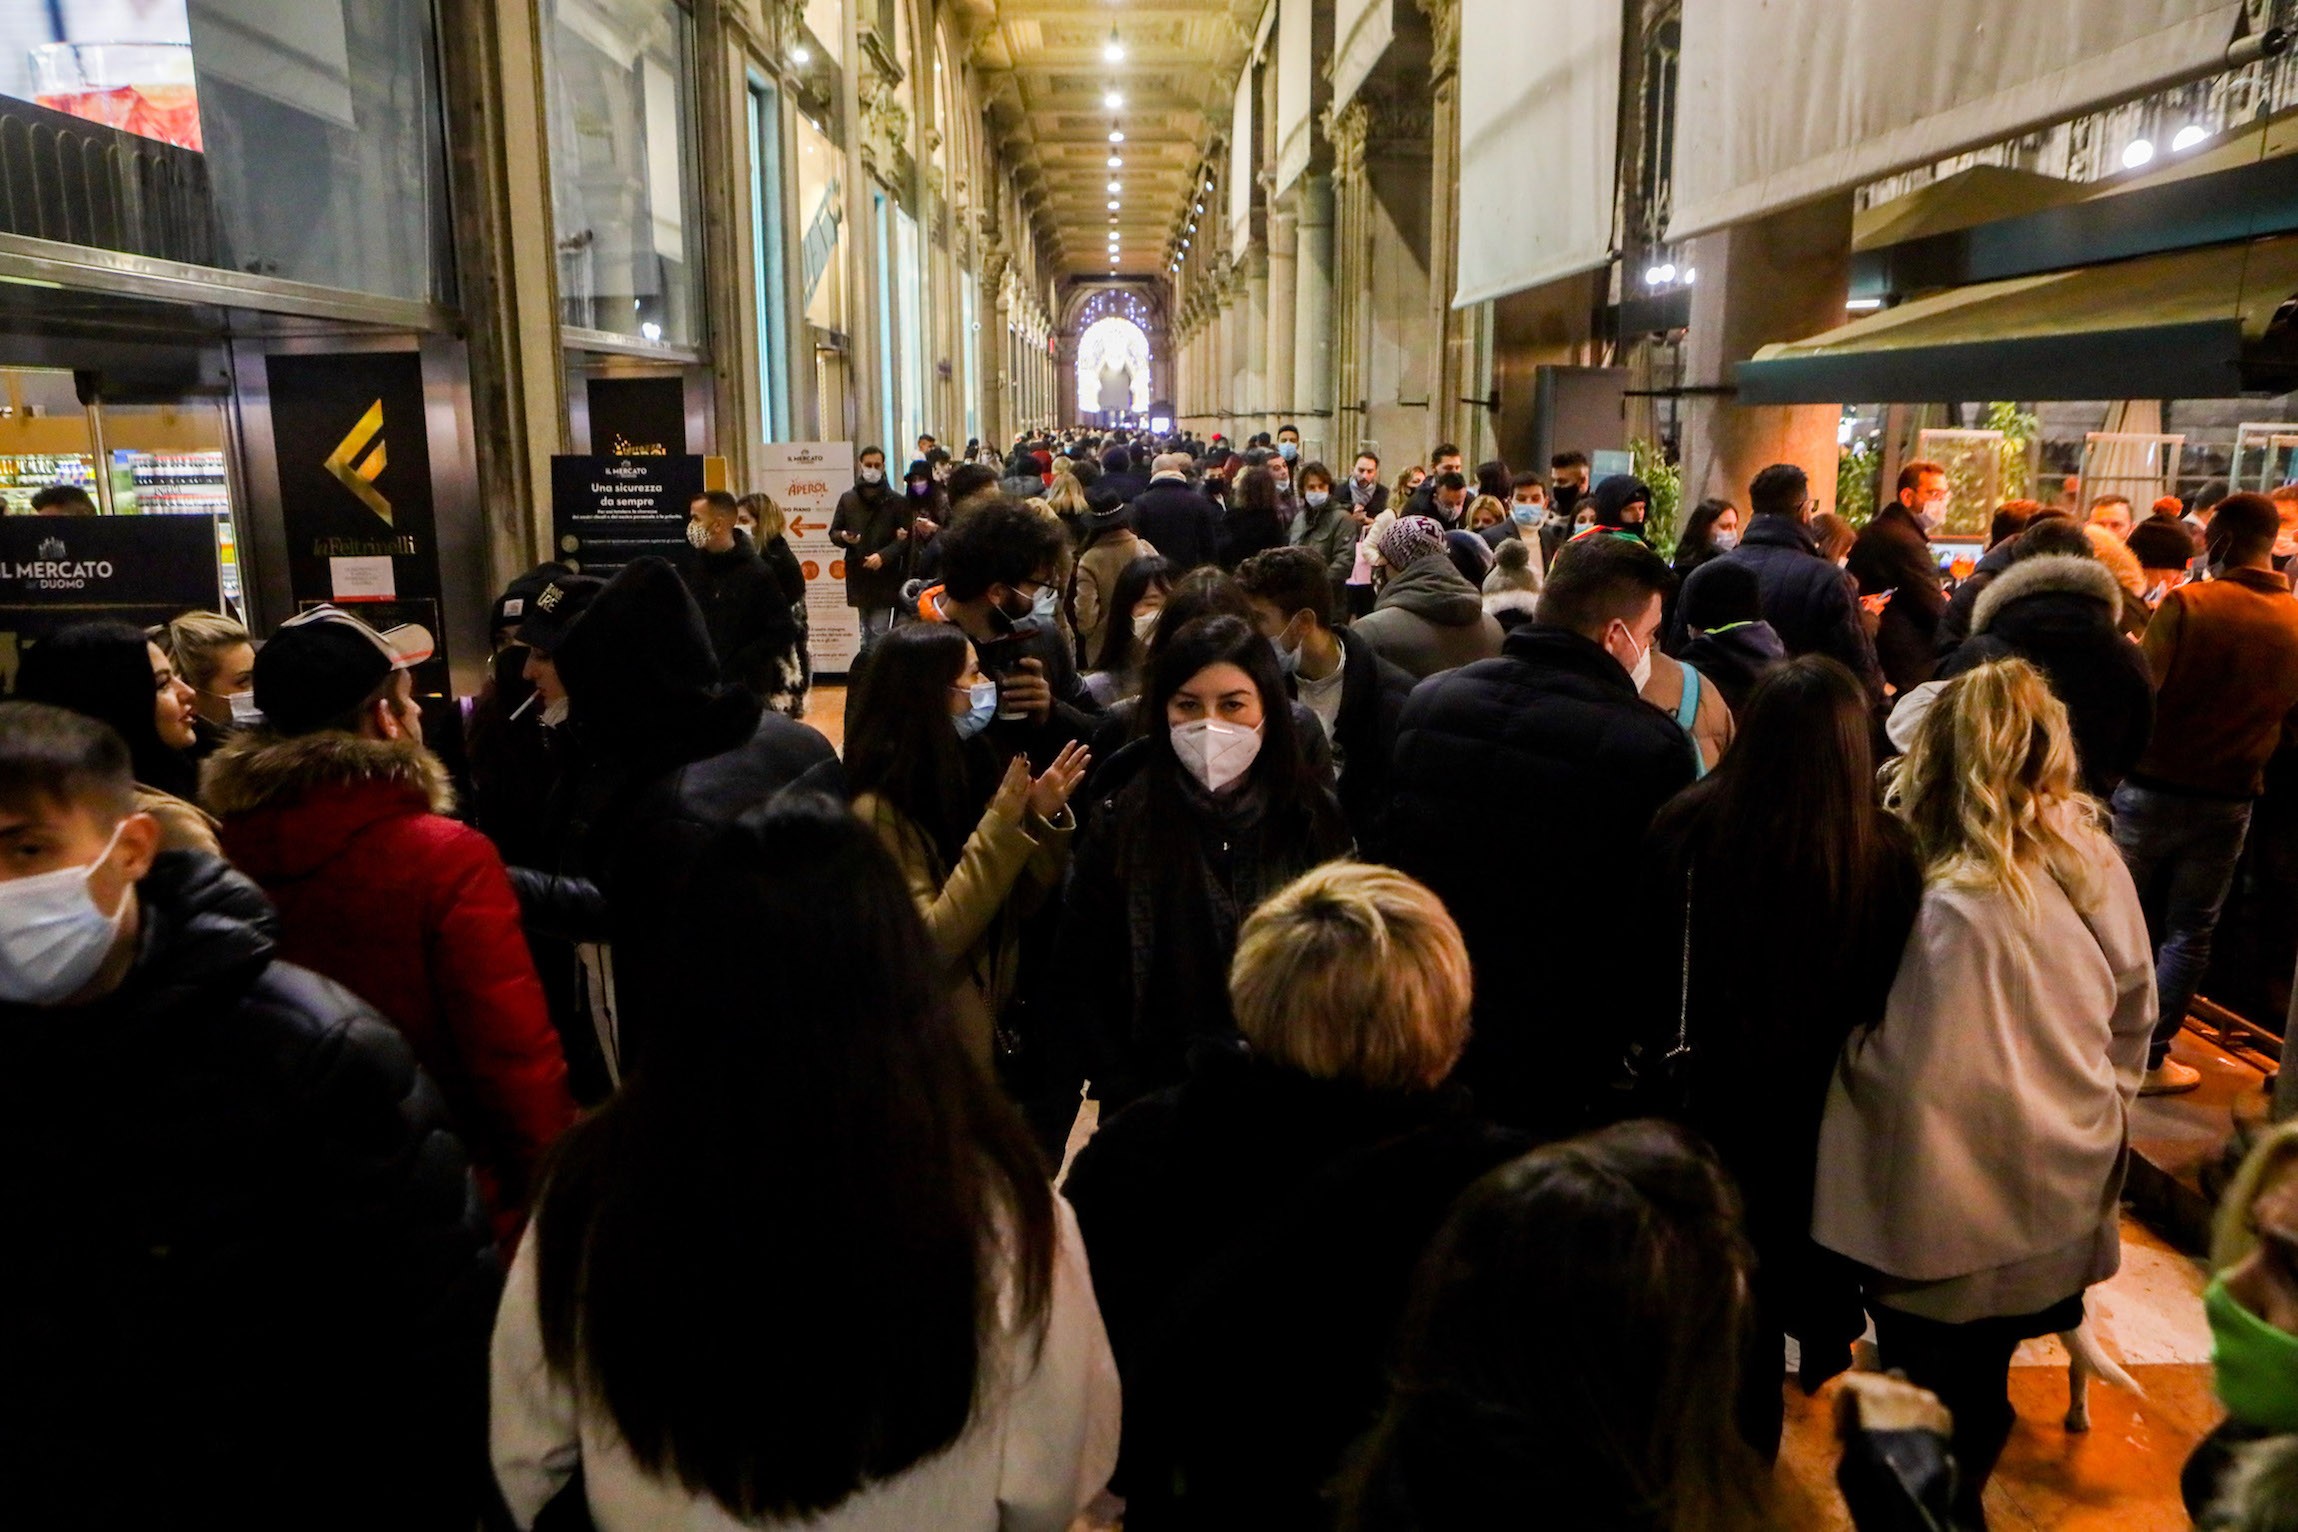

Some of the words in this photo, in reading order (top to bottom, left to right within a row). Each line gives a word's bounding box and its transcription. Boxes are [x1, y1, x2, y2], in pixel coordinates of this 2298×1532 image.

[612, 467, 648, 475] MERCATO
[591, 483, 613, 493] Una
[614, 482, 663, 493] sicurezza
[788, 482, 828, 497] APEROL
[600, 496, 614, 507] da
[616, 498, 655, 508] sempre
[0, 562, 13, 578] L
[17, 561, 113, 579] MERCATO
[40, 579, 85, 590] DUOMO
